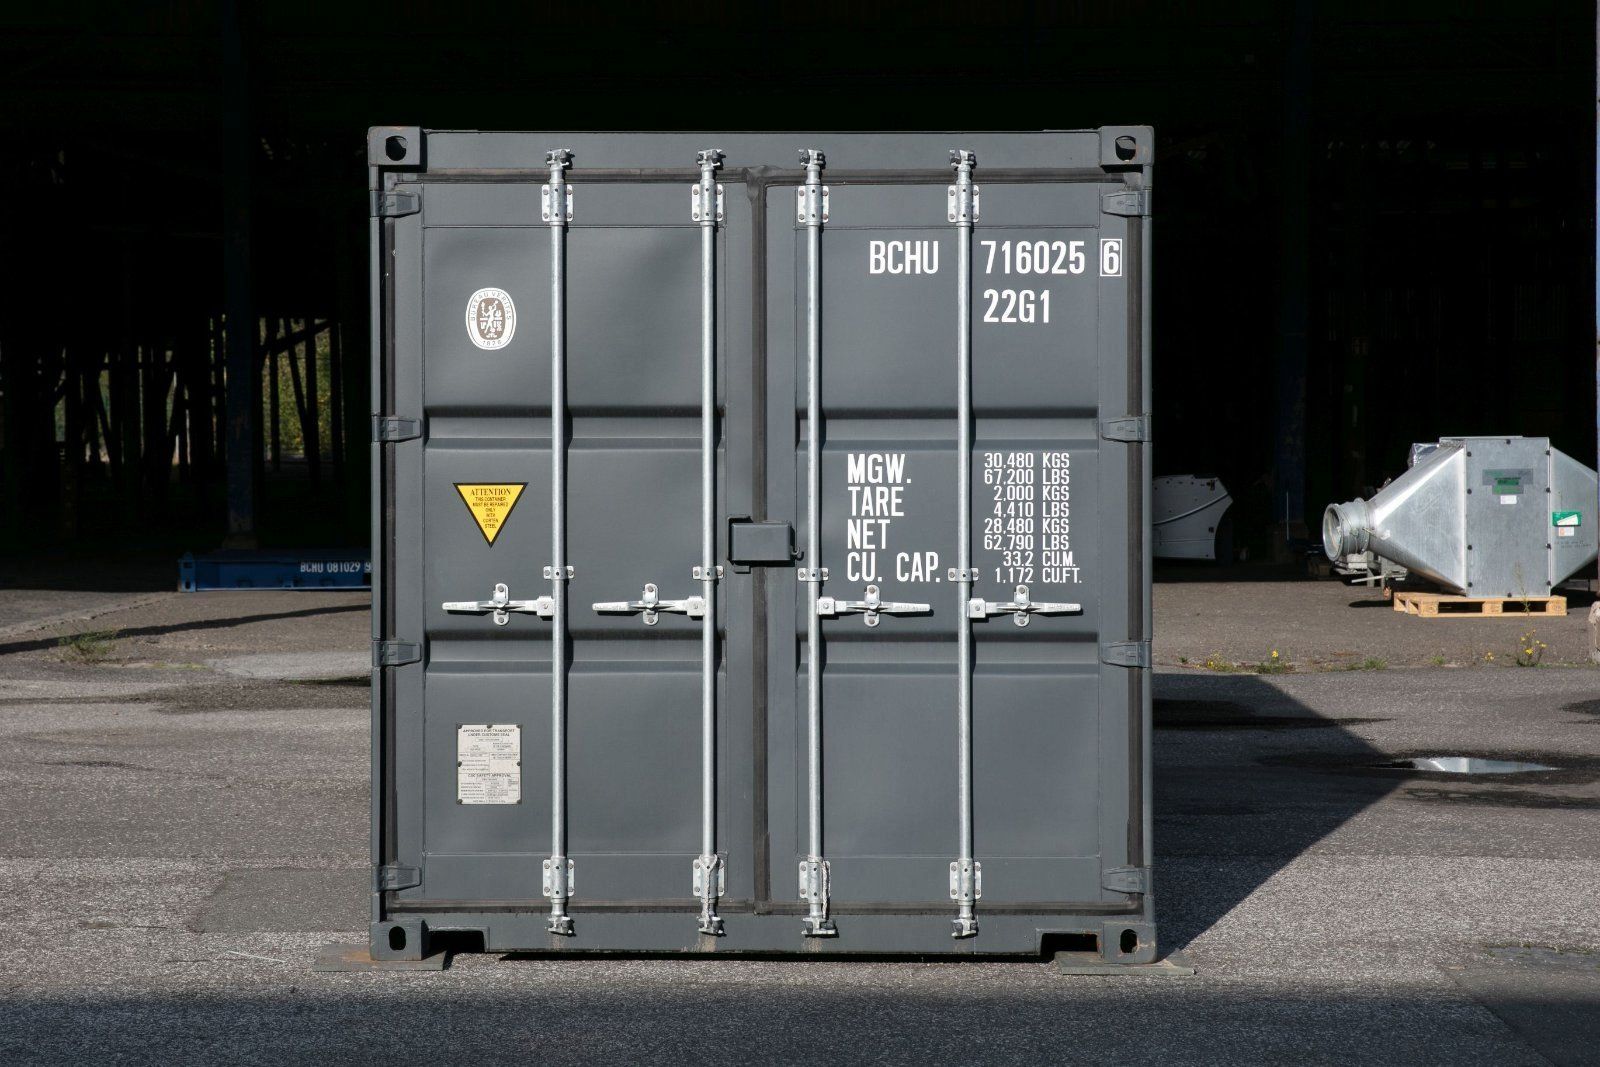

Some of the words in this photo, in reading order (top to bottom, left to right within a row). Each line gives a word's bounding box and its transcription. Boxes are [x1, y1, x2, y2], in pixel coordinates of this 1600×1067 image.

[869, 240, 939, 275] BCHU
[980, 240, 1086, 275] 716025
[1102, 241, 1120, 275] 6
[983, 288, 1050, 324] 22G1
[847, 453, 912, 484] MGW.
[984, 452, 1034, 469] 30,480
[1042, 452, 1070, 468] KGS
[984, 468, 1034, 485] 67,200
[1042, 469, 1070, 484] LBS
[471, 488, 511, 496] ATTENTION
[993, 485, 1034, 502] 2,000
[1042, 485, 1070, 501] KGS
[847, 485, 905, 517] TARE
[993, 502, 1034, 518] 4,410
[1042, 502, 1070, 517] LBS
[847, 518, 891, 550] NET
[984, 518, 1034, 535] 28,480
[1042, 518, 1070, 534] KGS
[984, 534, 1034, 551] 62,790
[1042, 534, 1070, 550] LBS
[300, 561, 324, 573] BCHU
[326, 561, 361, 573] 081029
[846, 551, 883, 583] CU.
[896, 551, 941, 583] CAP.
[1003, 551, 1034, 567] 33.2
[1042, 551, 1077, 567] CU.M.
[995, 567, 1034, 584] 1,172
[1042, 567, 1083, 584] CU.FT.
